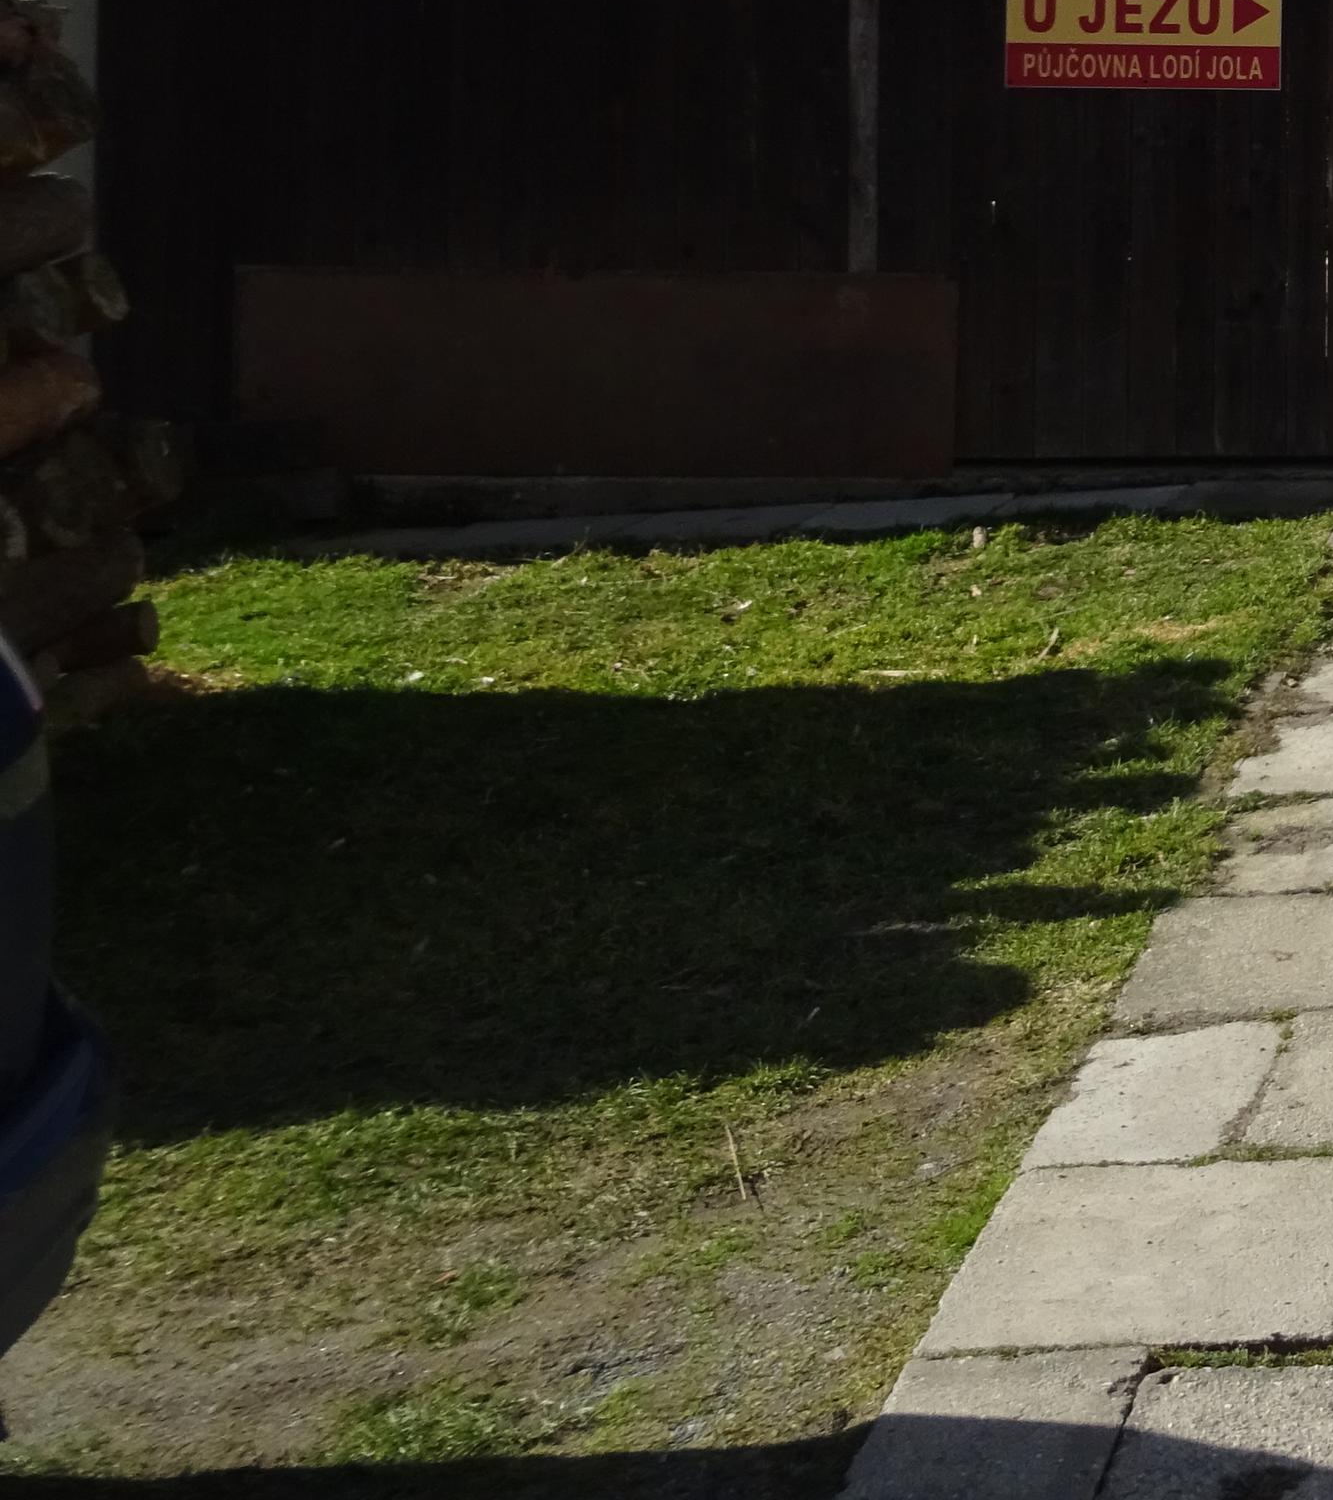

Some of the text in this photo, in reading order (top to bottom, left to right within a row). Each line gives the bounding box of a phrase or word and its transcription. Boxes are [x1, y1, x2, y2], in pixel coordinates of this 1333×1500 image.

[1022, 48, 1264, 81] PŮJČOVNA LODÍ JOLA
